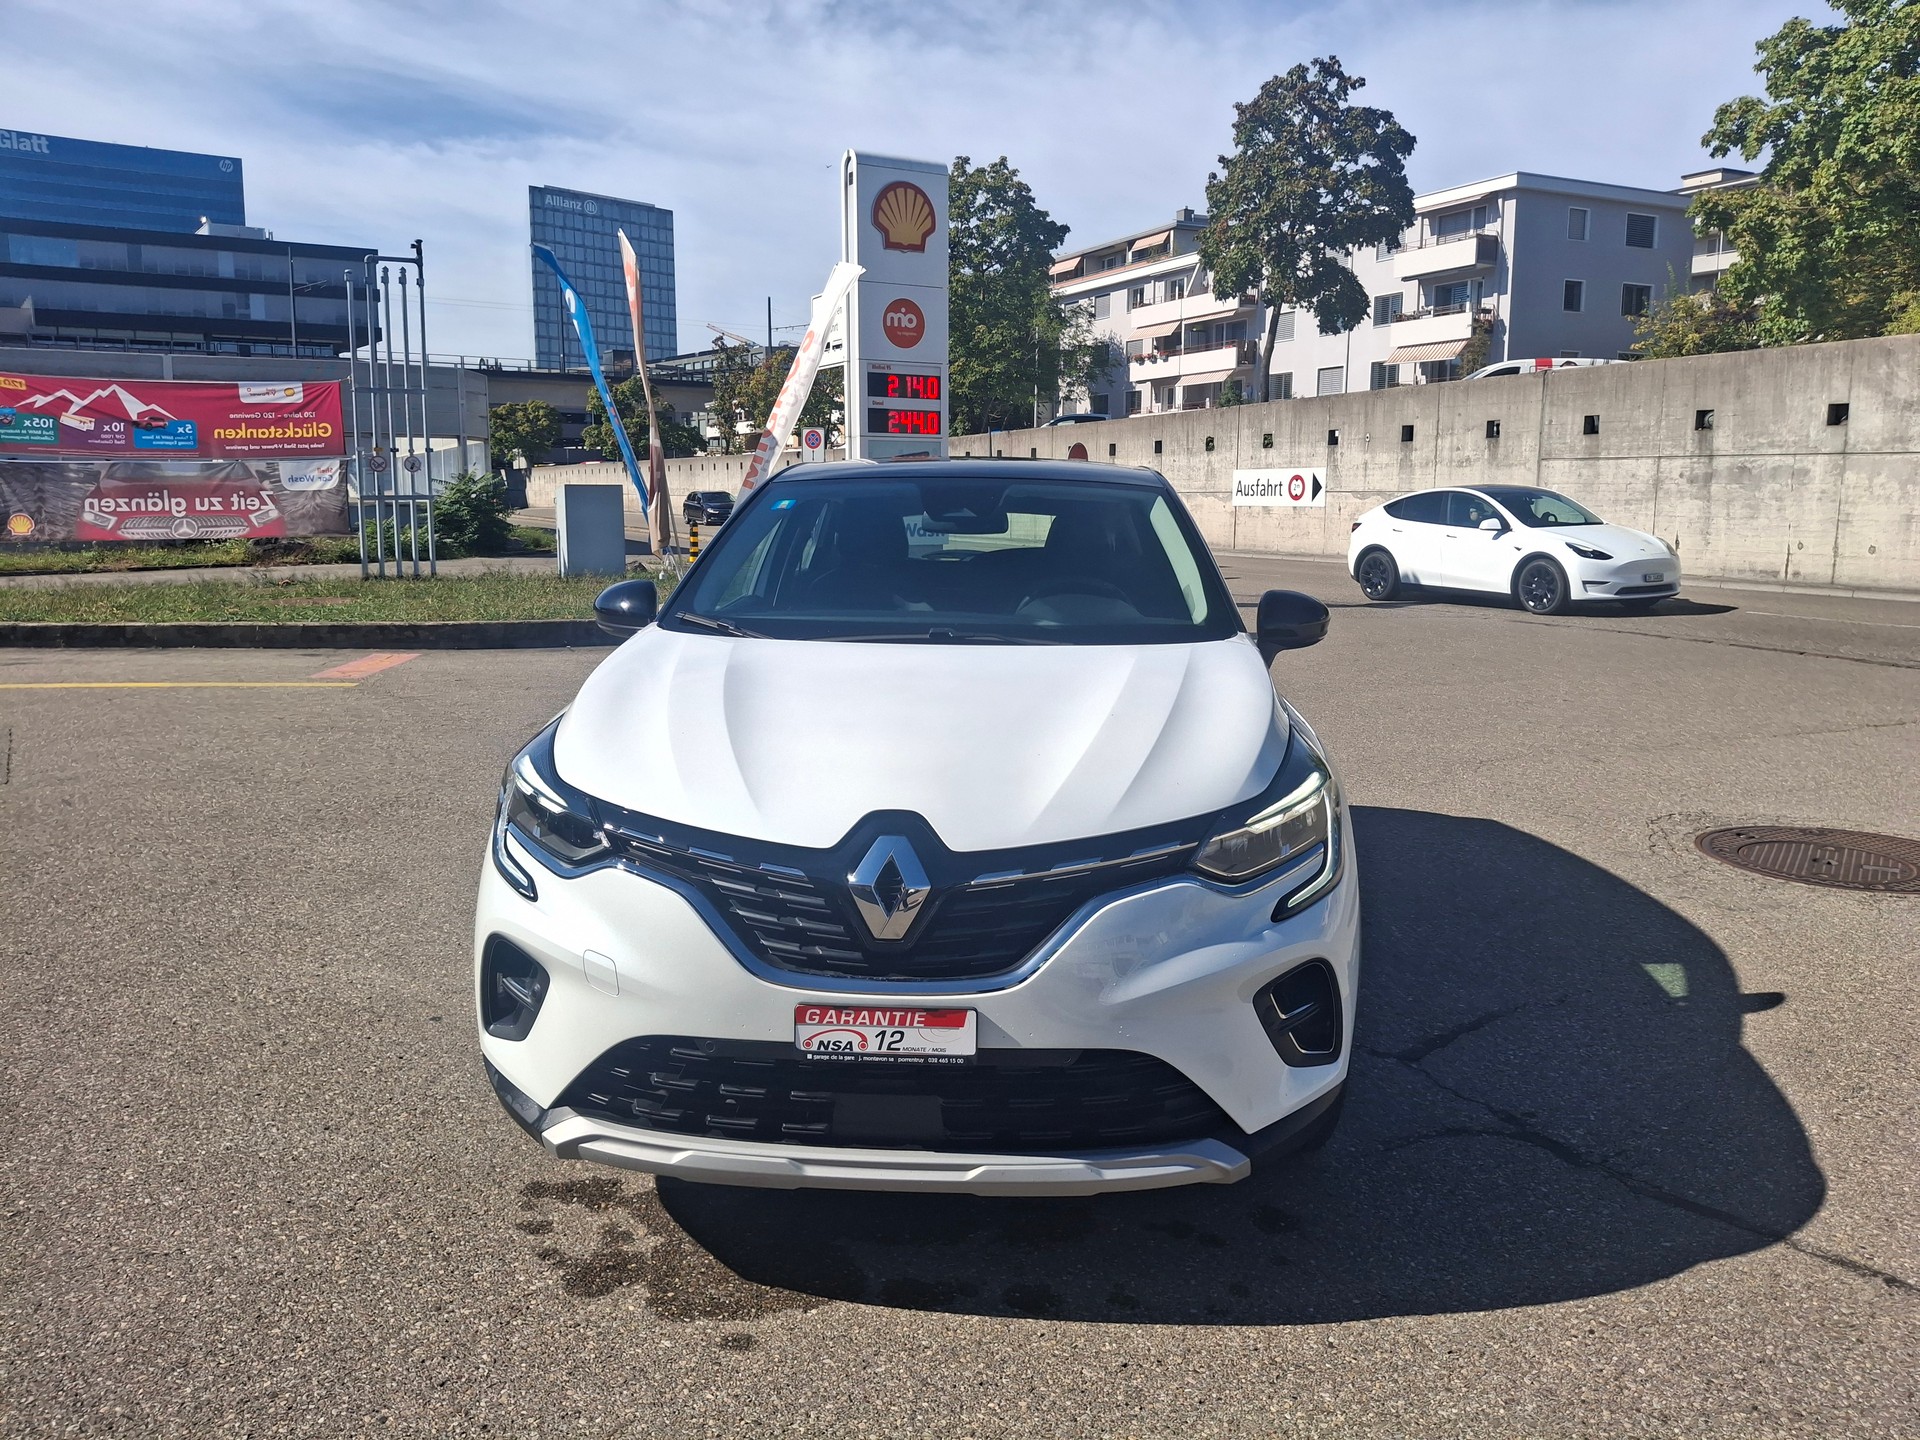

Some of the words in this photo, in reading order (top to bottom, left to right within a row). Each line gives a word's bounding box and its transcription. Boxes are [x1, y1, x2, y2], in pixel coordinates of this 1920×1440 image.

[0, 130, 50, 154] Glatt
[220, 159, 233, 172] hp
[545, 194, 582, 210] Allianz
[887, 307, 917, 328] mio
[888, 410, 938, 434] 244.0
[1235, 478, 1283, 497] Ausfahrt
[805, 1009, 926, 1027] GARANTIE
[816, 1040, 854, 1051] NSA
[875, 1030, 905, 1051] 12
